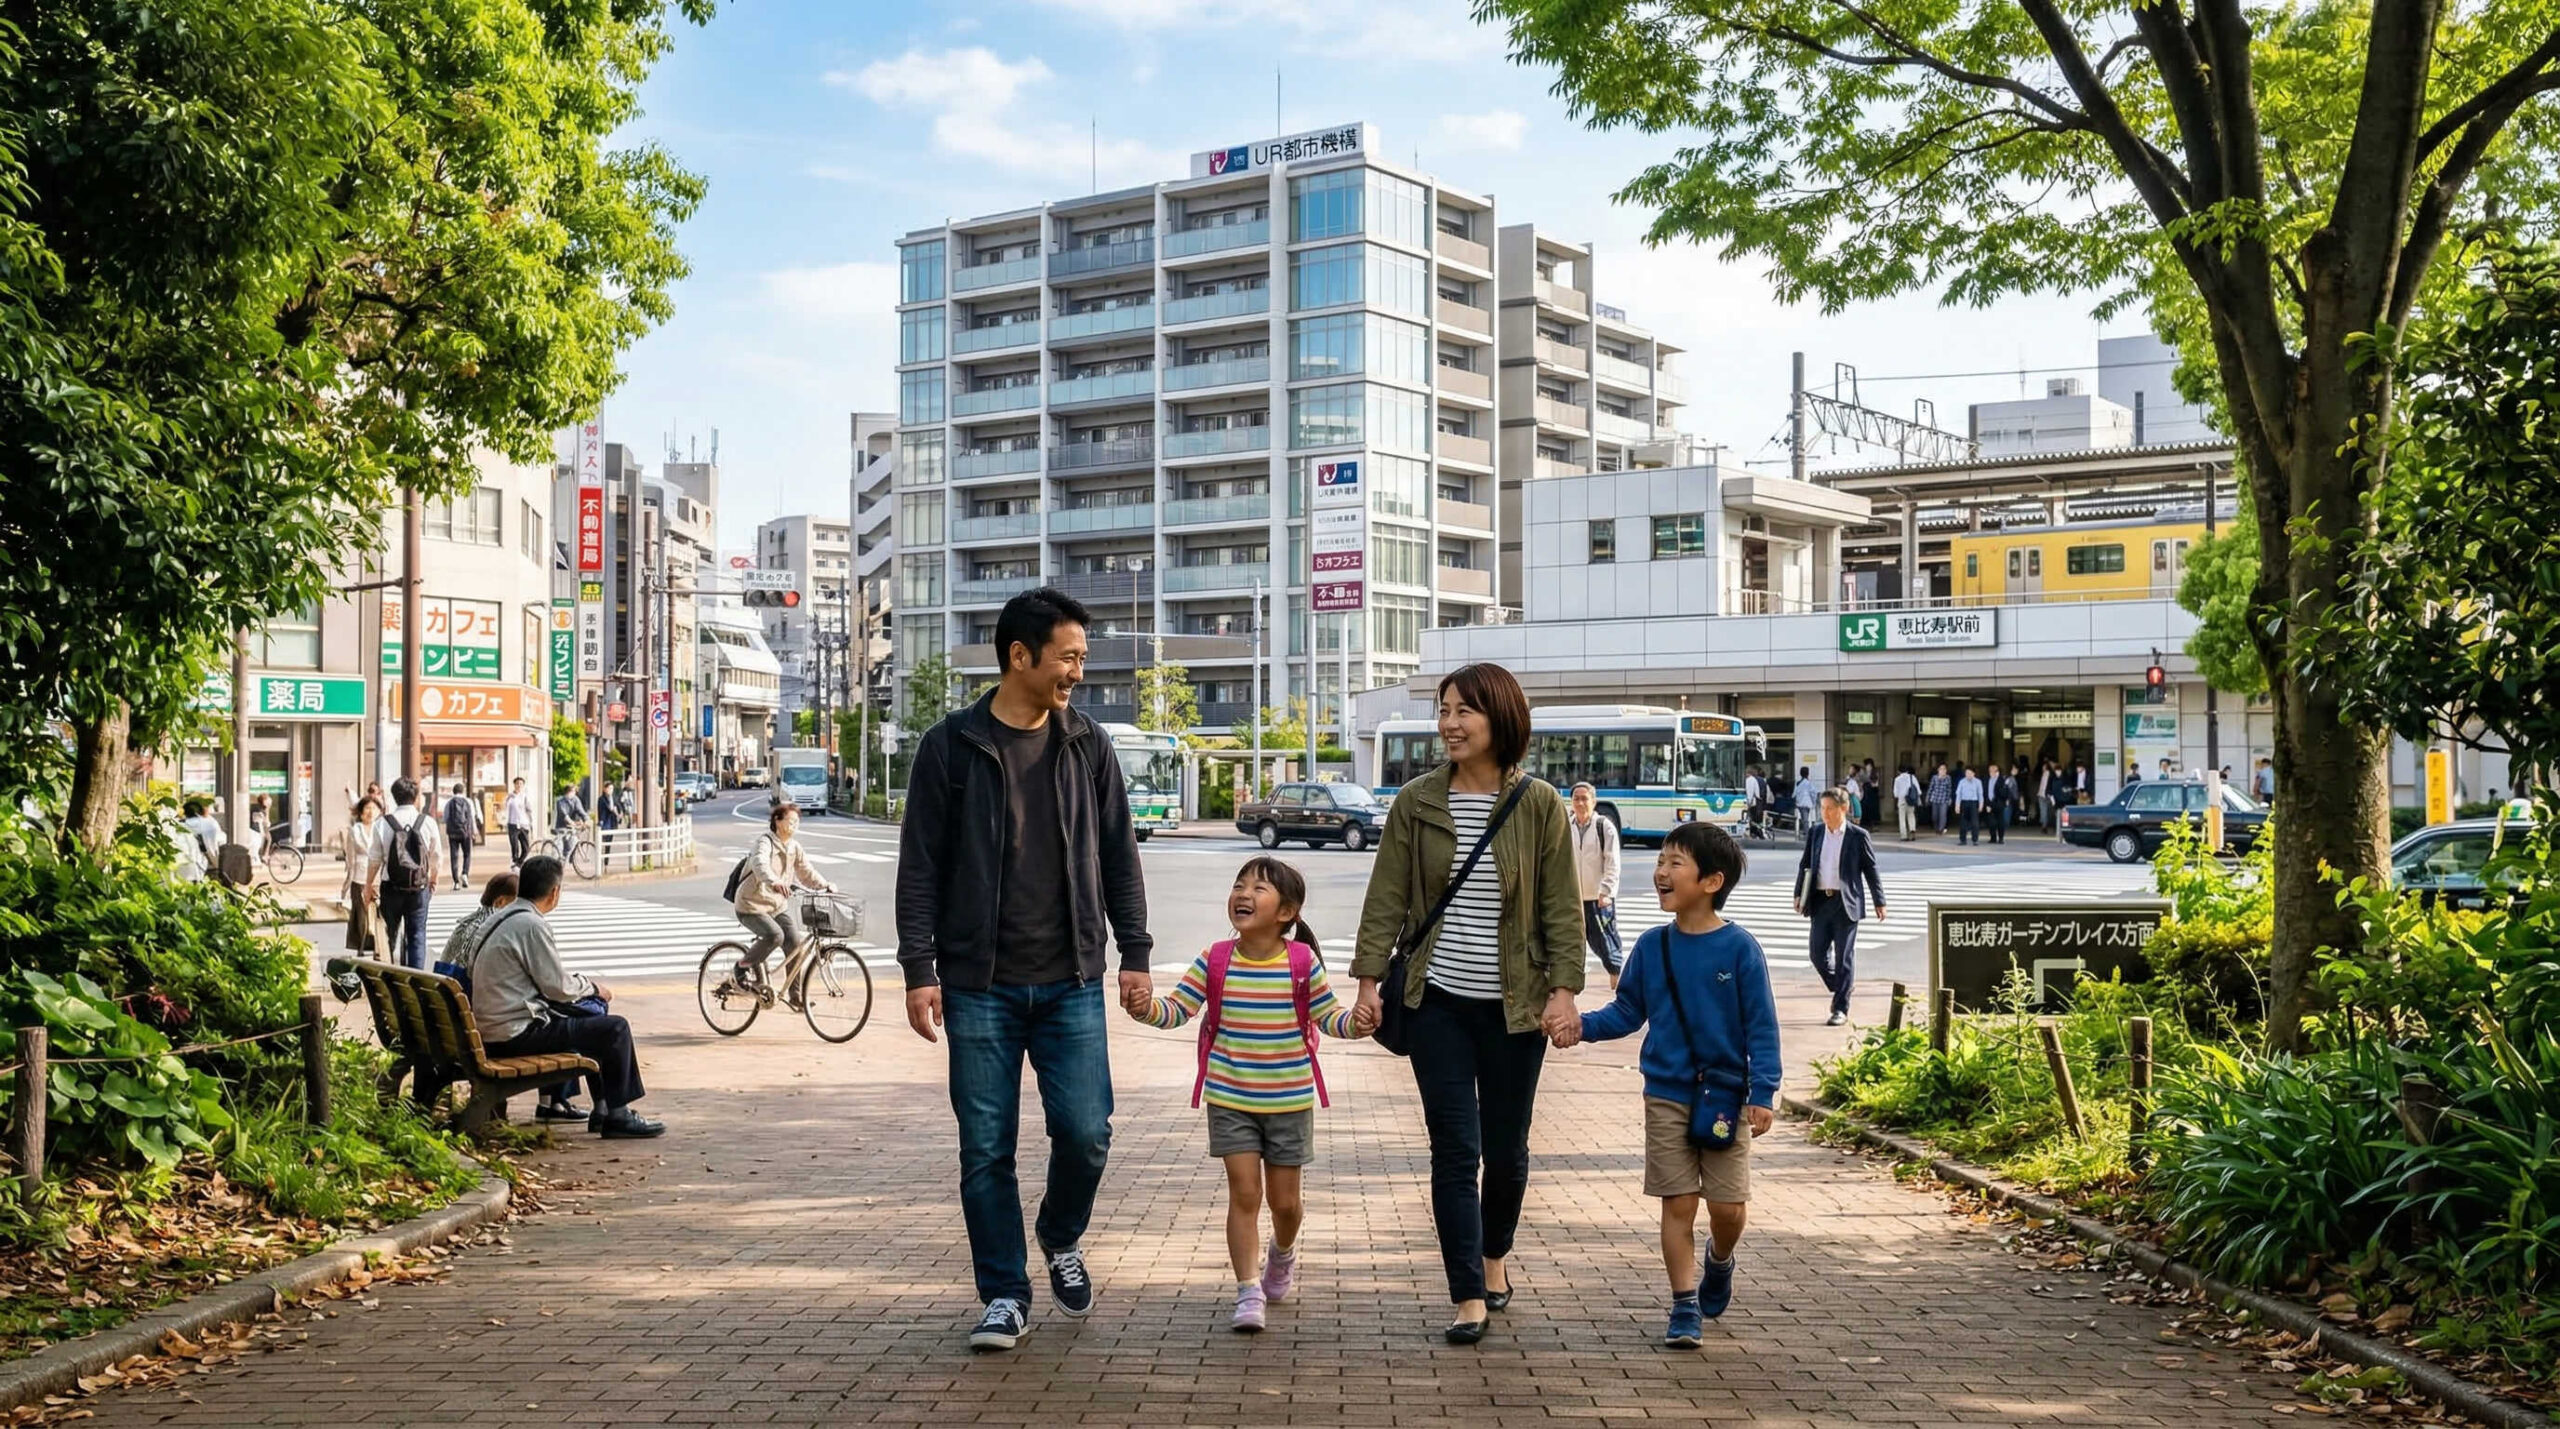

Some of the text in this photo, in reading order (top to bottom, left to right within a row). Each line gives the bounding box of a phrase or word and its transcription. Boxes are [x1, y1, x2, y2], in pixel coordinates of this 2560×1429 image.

[426, 607, 496, 636] カフェ
[1845, 618, 1880, 640] JR
[1898, 615, 1980, 636] 恵比寿駅前
[267, 680, 324, 711] 薬局
[448, 690, 503, 715] カフェ
